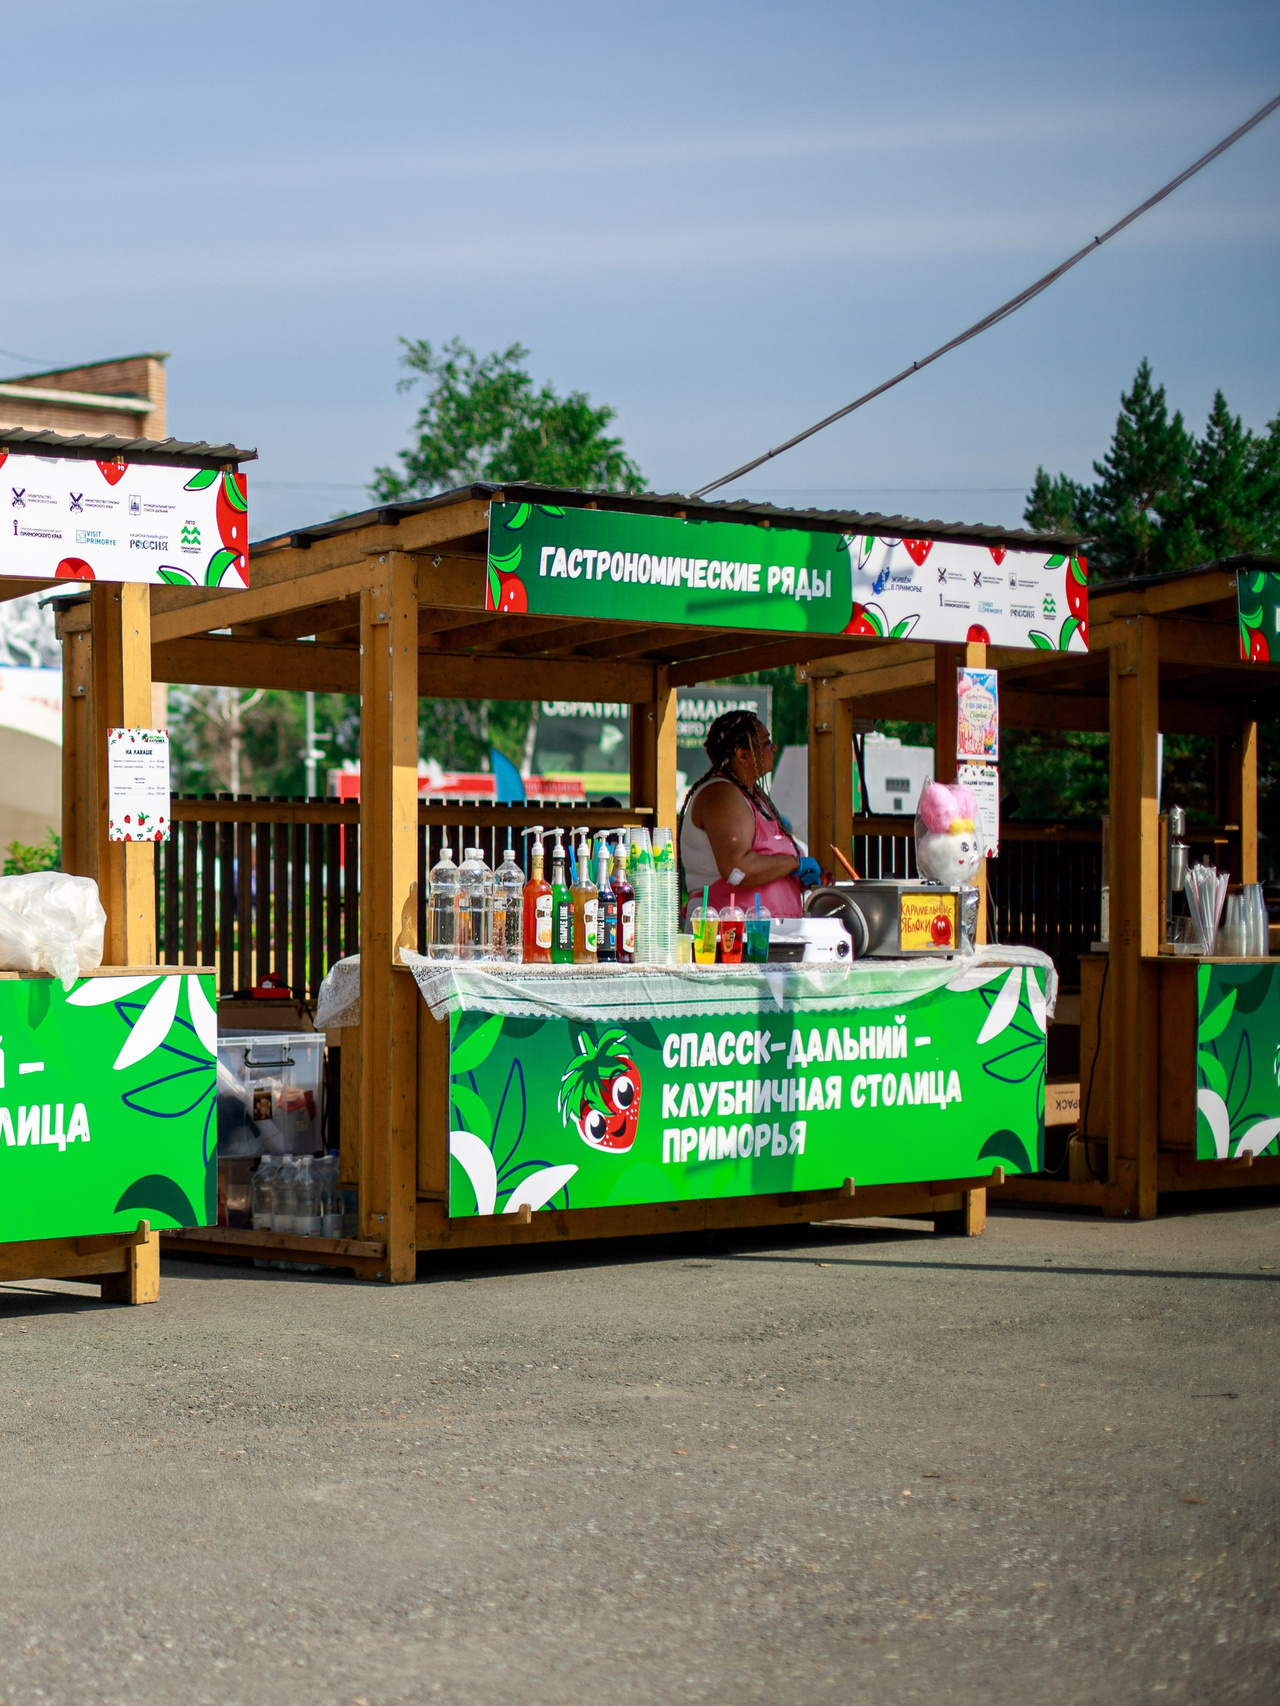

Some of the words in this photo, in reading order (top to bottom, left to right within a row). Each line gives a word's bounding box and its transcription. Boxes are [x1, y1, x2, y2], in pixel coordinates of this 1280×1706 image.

[20, 531, 51, 539] ПРИМОРСКОГО
[86, 537, 117, 546] PRIMORYE
[129, 539, 168, 551] РОССИЯ
[539, 544, 761, 593] ГАСТРОНОМИЧЕСКИЕ
[767, 564, 832, 602] РЯДЫ
[895, 584, 923, 593] ПРИМОРЬЕ
[559, 921, 568, 944] SIMPLE
[901, 917, 931, 934] ЯБЛОКИ
[661, 1014, 908, 1068] СПАССК-ДАЛЬНИЙ
[661, 1074, 841, 1119] КЛУБНИЧНАЯ
[850, 1069, 962, 1109] СТОЛИЦА
[661, 1120, 807, 1164] ПРИМОРЬЯ
